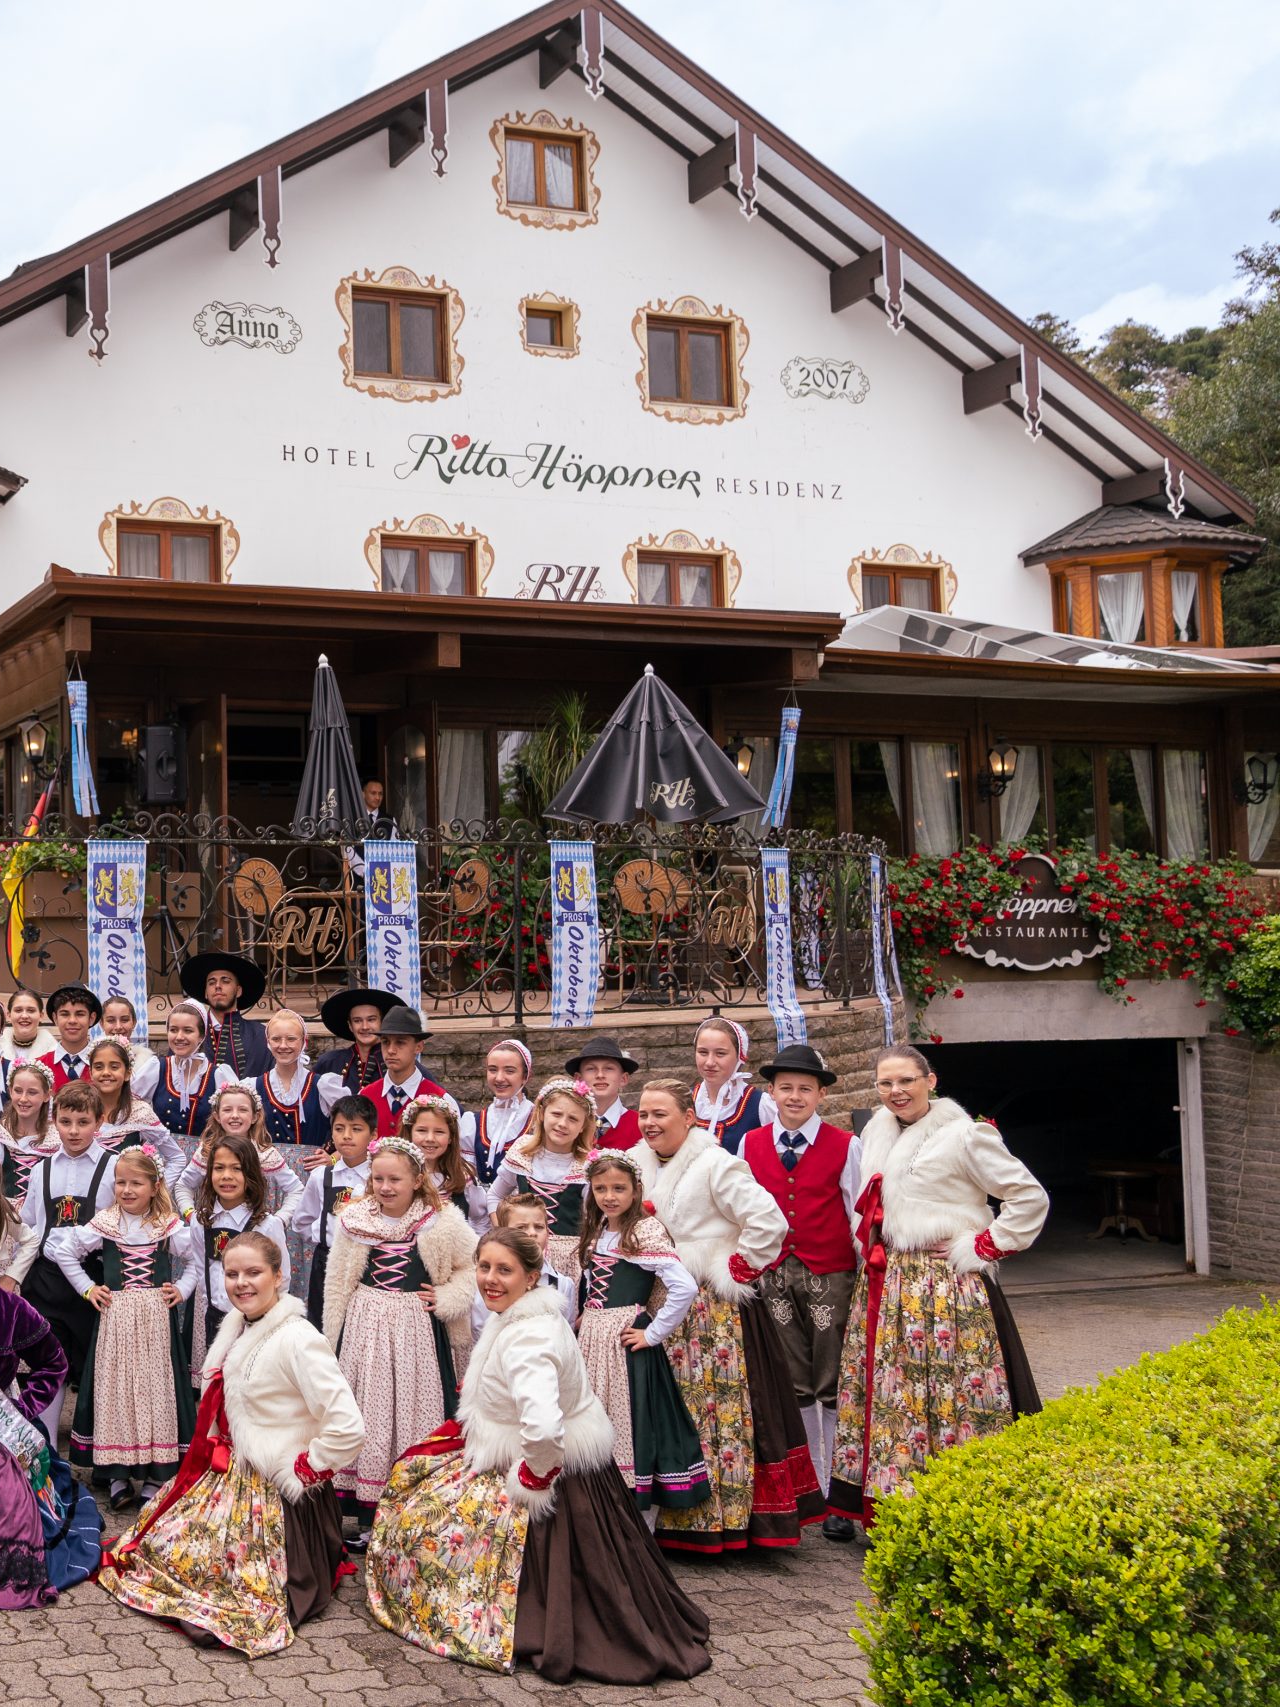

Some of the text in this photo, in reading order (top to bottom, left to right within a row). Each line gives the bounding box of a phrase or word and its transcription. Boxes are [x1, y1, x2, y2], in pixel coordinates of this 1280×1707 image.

[215, 310, 279, 340] Anno
[799, 366, 852, 390] 2007
[282, 433, 843, 501] HOTEL Ritta Höppner RESIDENZ
[525, 563, 600, 602] RH
[100, 919, 131, 929] PROST
[377, 916, 406, 925] PROST
[562, 912, 588, 921] PROST
[564, 925, 584, 1028] Oktoberfe
[774, 926, 797, 1041] Oktoberfest
